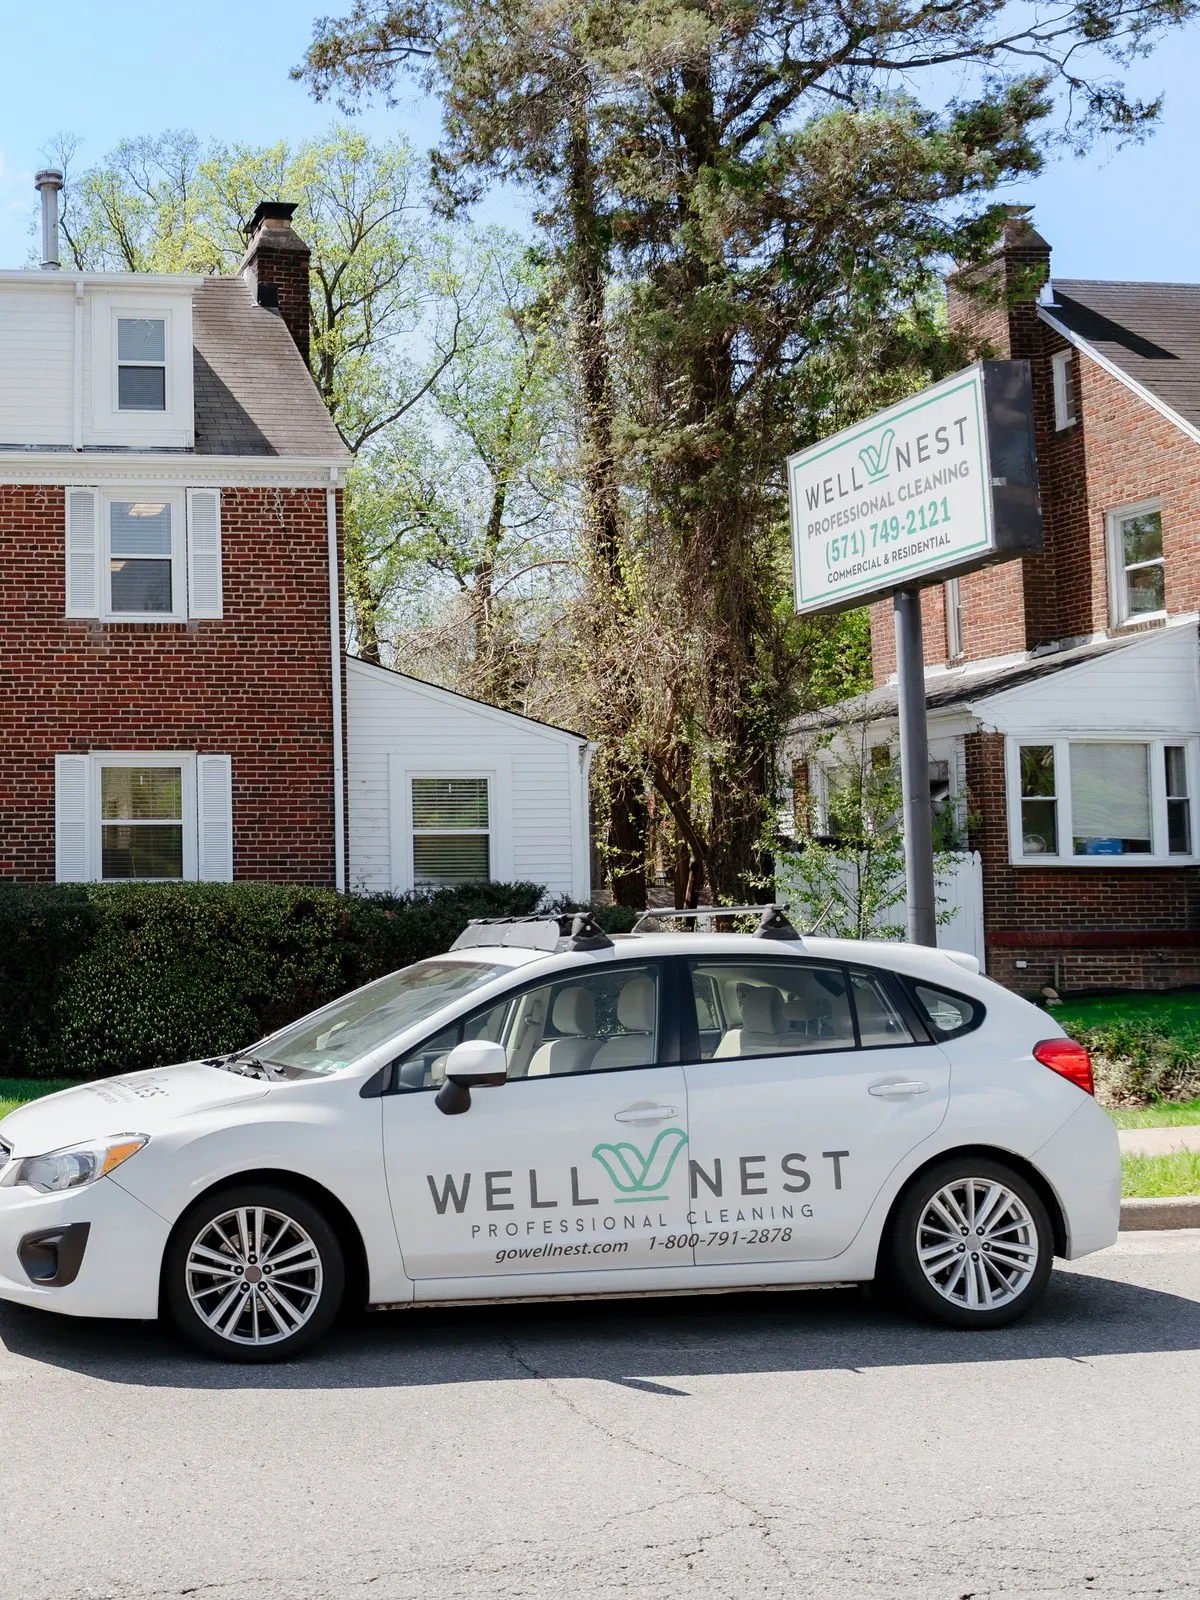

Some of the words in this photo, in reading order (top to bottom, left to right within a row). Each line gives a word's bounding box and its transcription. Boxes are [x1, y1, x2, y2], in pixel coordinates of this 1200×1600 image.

[805, 467, 864, 512] WELL
[896, 416, 968, 473] NEST
[807, 491, 895, 540] PROFESSIONAL
[898, 459, 970, 502] CLEANING
[825, 528, 865, 569] (571)
[869, 496, 951, 548] 749-2121
[827, 556, 882, 584] COMMERCIAL
[883, 553, 890, 565] &
[892, 532, 951, 563] RESIDENTIAL
[426, 1166, 599, 1215] WELL
[688, 1150, 851, 1199] NEST
[471, 1213, 668, 1239] PROFESSIONAL
[686, 1203, 815, 1225] CLEANING
[495, 1240, 629, 1263] gowellnest.com
[649, 1226, 793, 1251] 1-800-791-2878
